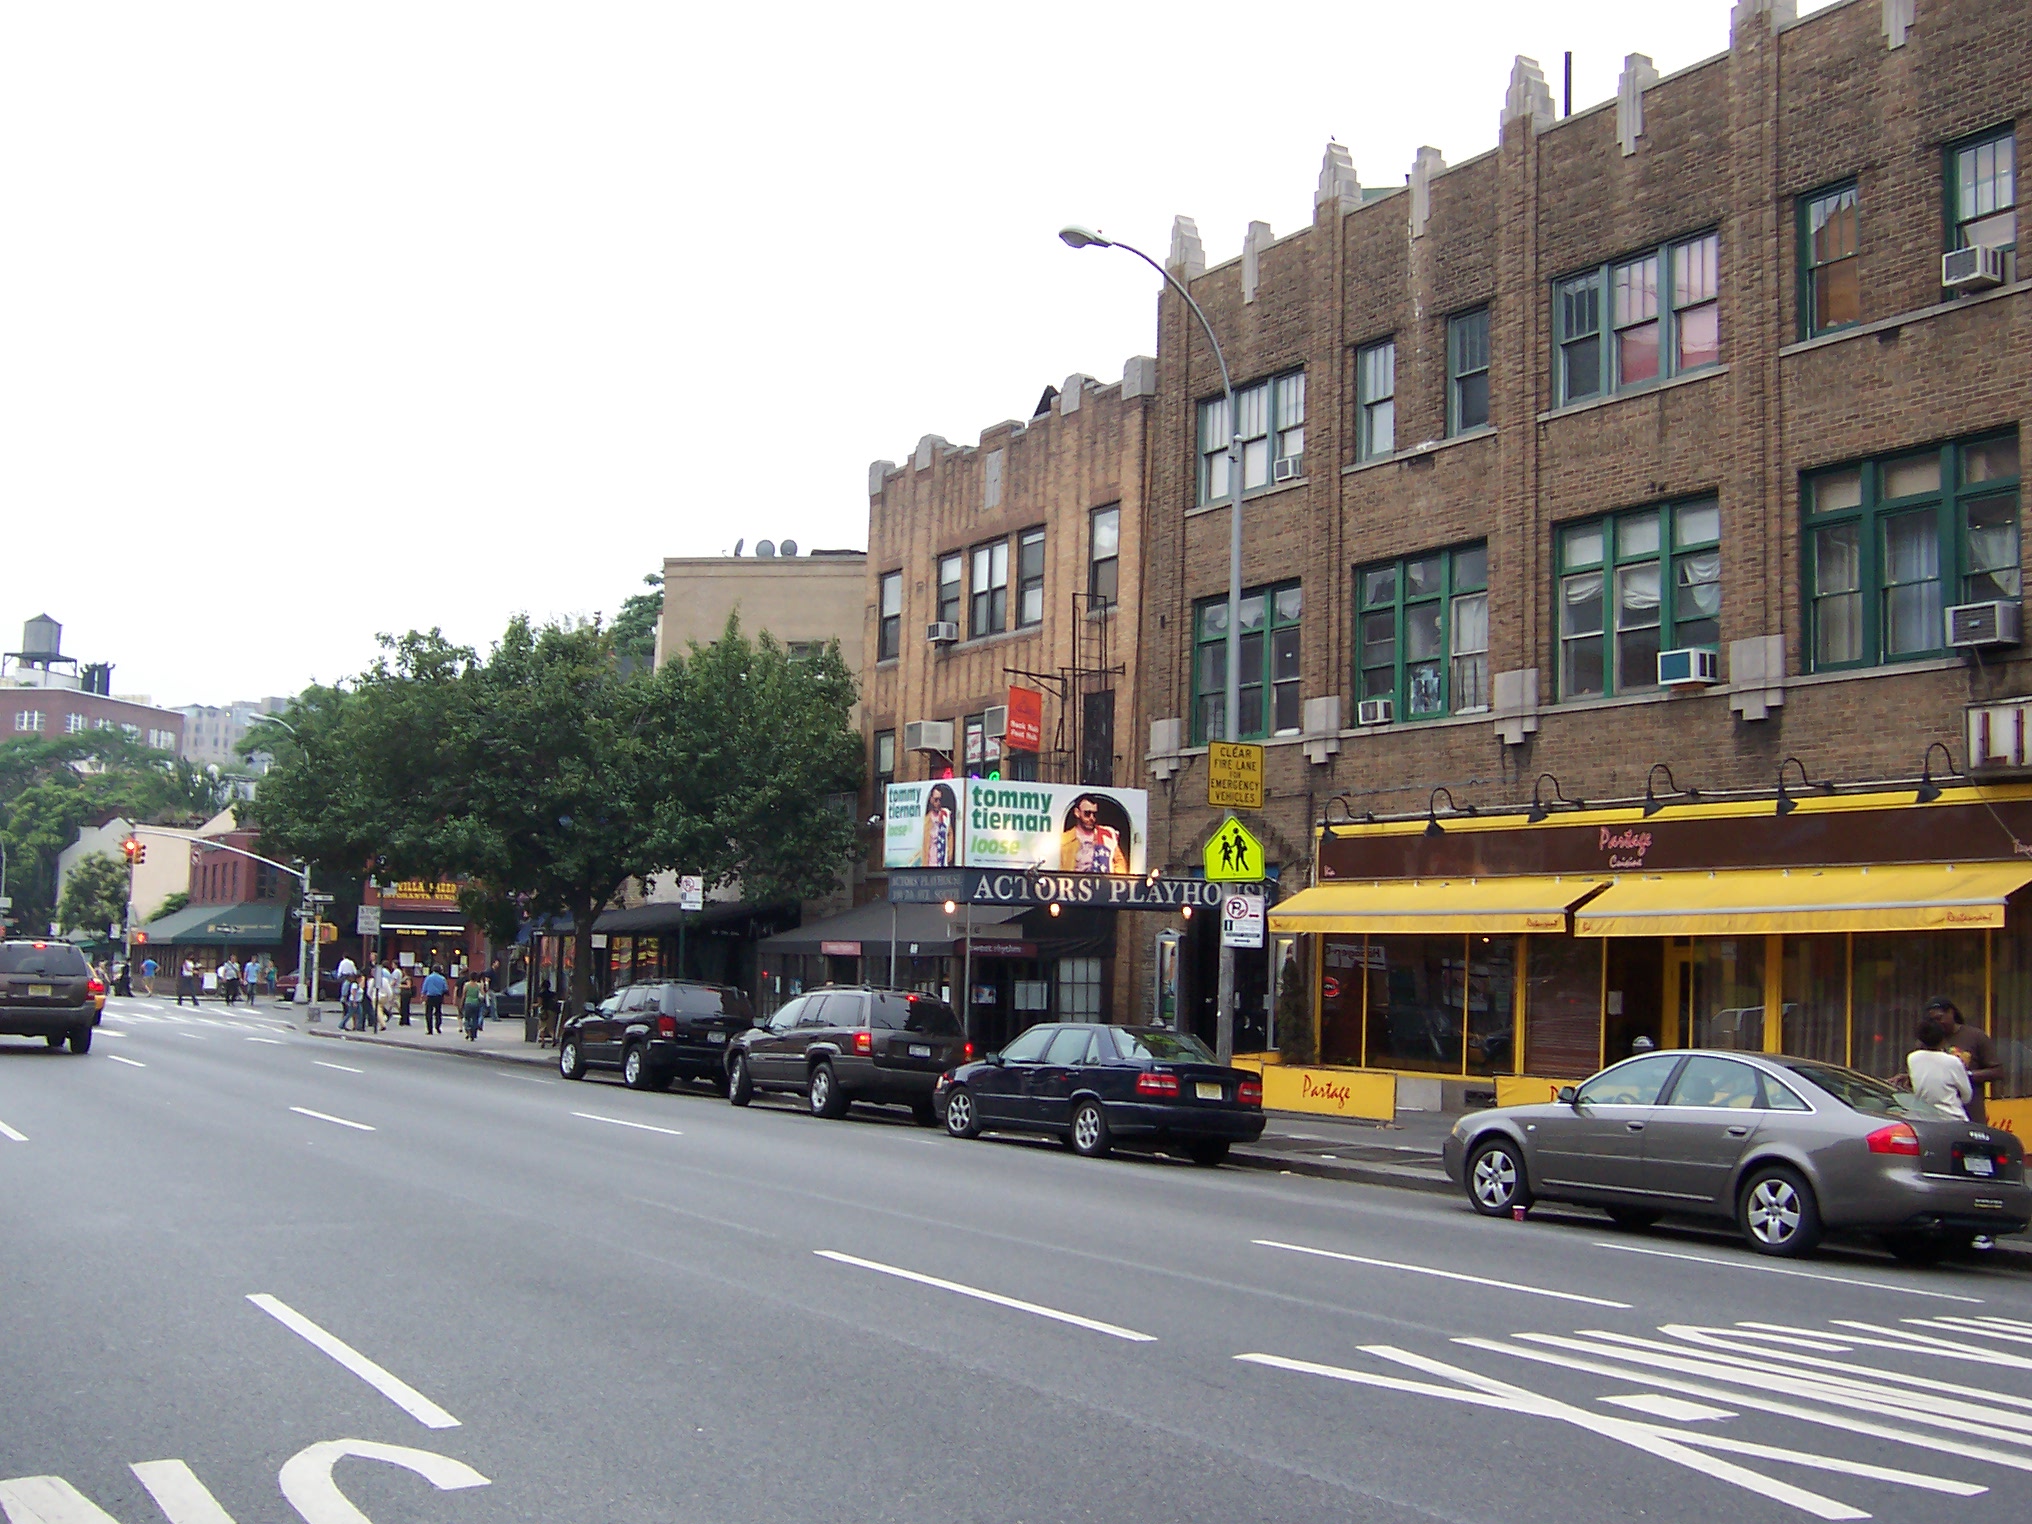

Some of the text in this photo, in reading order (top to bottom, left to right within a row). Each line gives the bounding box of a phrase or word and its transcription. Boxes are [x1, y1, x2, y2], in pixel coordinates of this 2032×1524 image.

[1220, 746, 1252, 758] CLEAR
[1214, 759, 1257, 772] FIRE LANE
[1211, 778, 1260, 791] EMERGENCY
[888, 786, 922, 804] tommy
[972, 785, 1053, 814] tommy
[1215, 791, 1255, 803] VEHICLES
[888, 803, 921, 819] tiernan
[972, 807, 1052, 833] tiernan
[970, 833, 1020, 855] loose
[973, 874, 1100, 903] ACTORS'
[1108, 880, 1273, 908] PLAYHOSE
[1302, 1074, 1351, 1109] Partage
